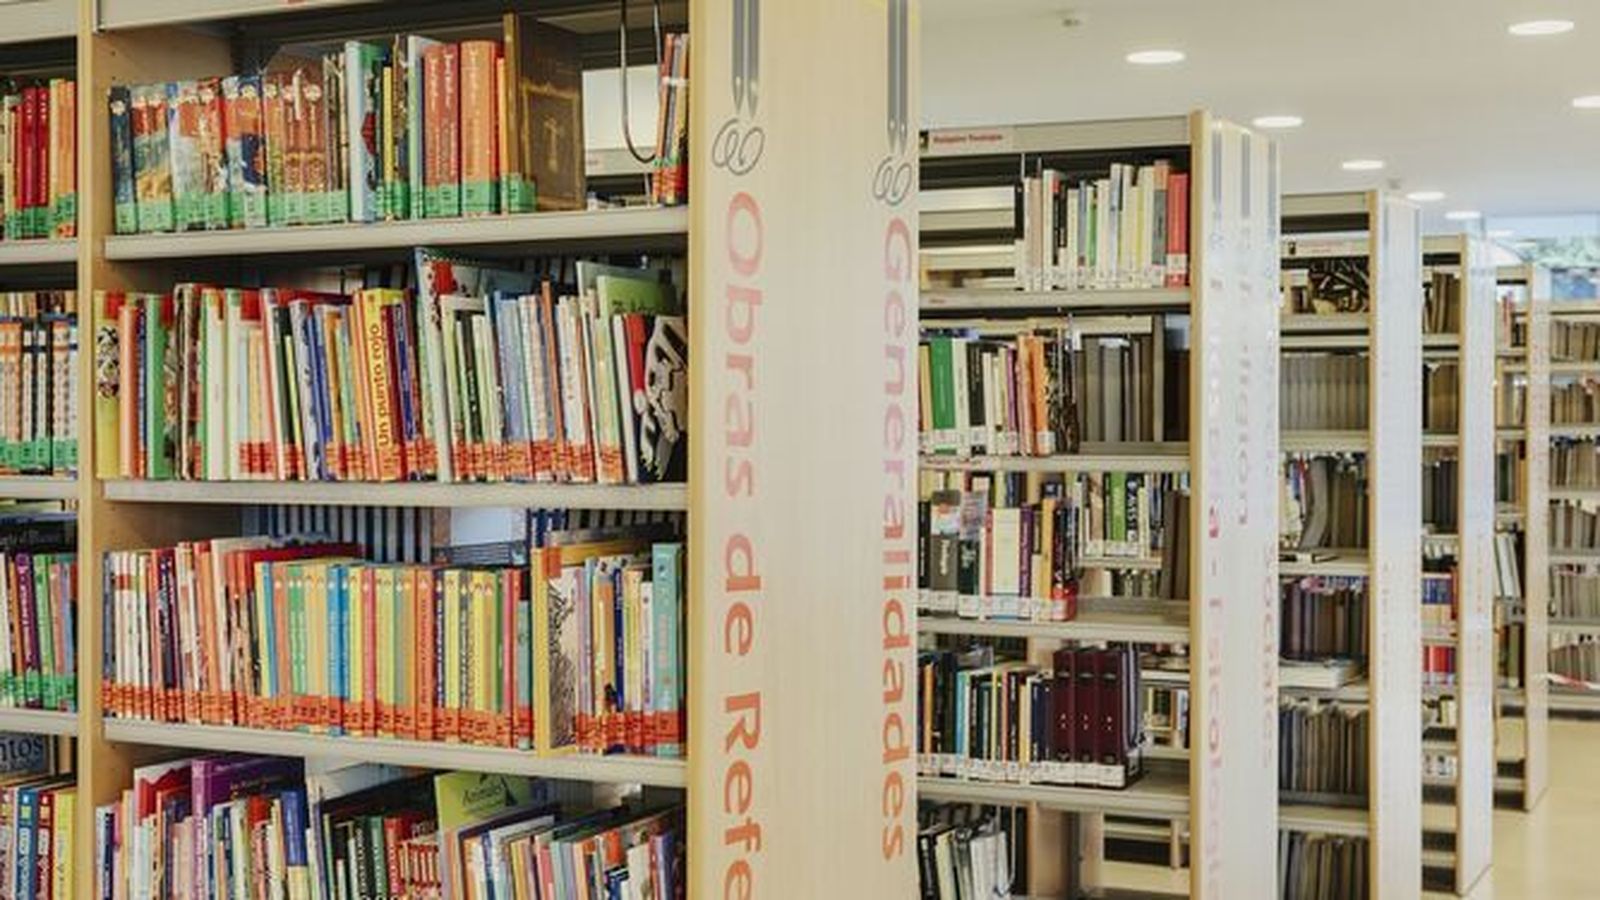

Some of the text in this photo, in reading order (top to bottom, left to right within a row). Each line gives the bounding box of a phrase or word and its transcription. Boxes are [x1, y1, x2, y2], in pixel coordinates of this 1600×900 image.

[369, 323, 393, 447] Un punto rojo
[723, 191, 763, 900] Obras de Refe
[882, 217, 912, 862] Generalidades
